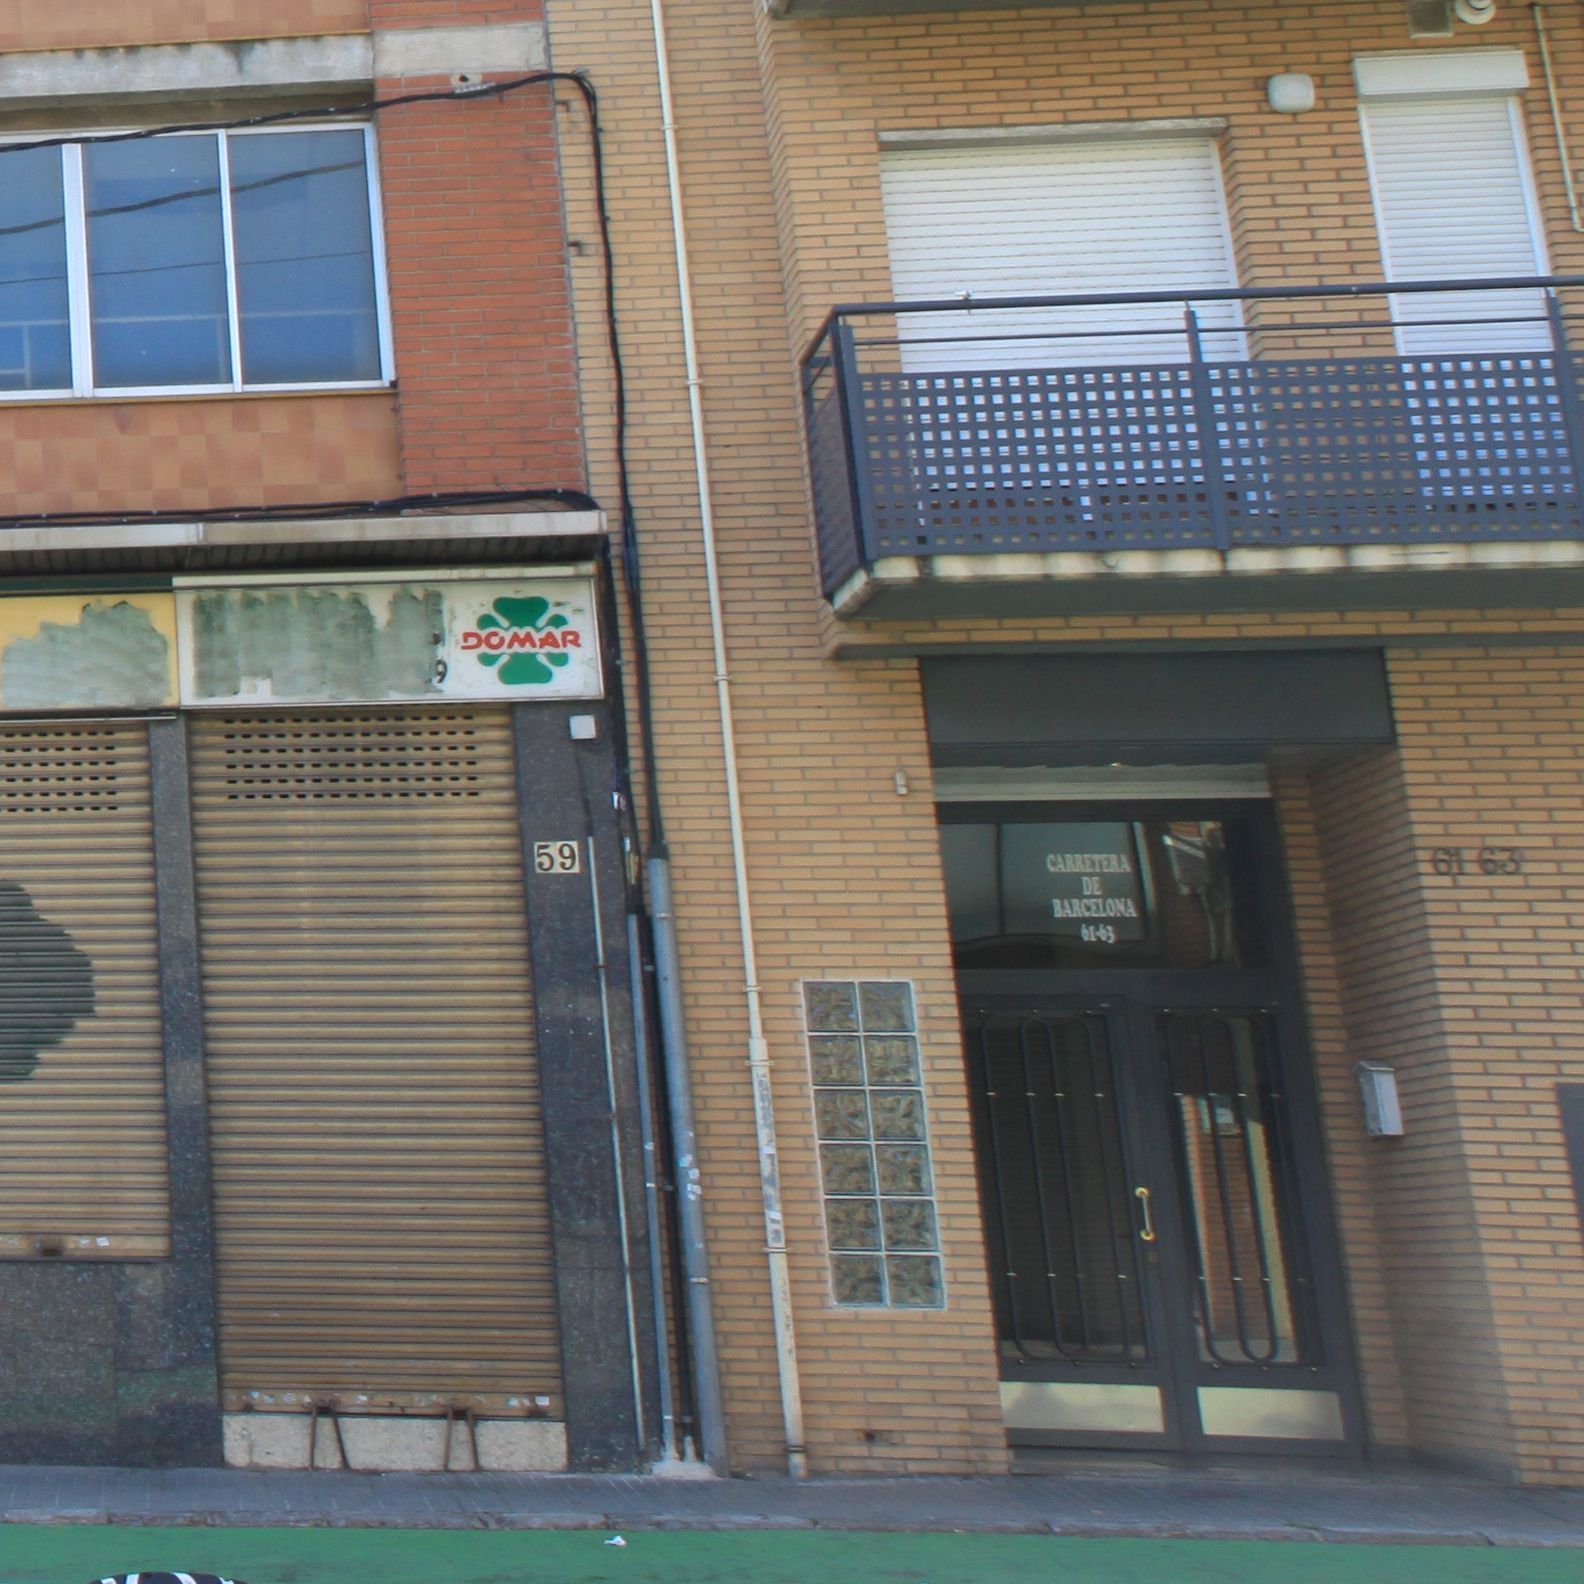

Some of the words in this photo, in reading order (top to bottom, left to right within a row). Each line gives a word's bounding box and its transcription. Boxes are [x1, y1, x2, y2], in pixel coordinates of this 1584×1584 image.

[461, 630, 581, 650] DOMAR
[536, 843, 576, 872] 59
[1046, 853, 1131, 872] CARRETERA
[1433, 847, 1463, 876] 61
[1479, 847, 1521, 876] 63
[1081, 876, 1102, 895] DE
[1052, 897, 1136, 917] BARCELONA
[1080, 923, 1116, 943] 61-63
